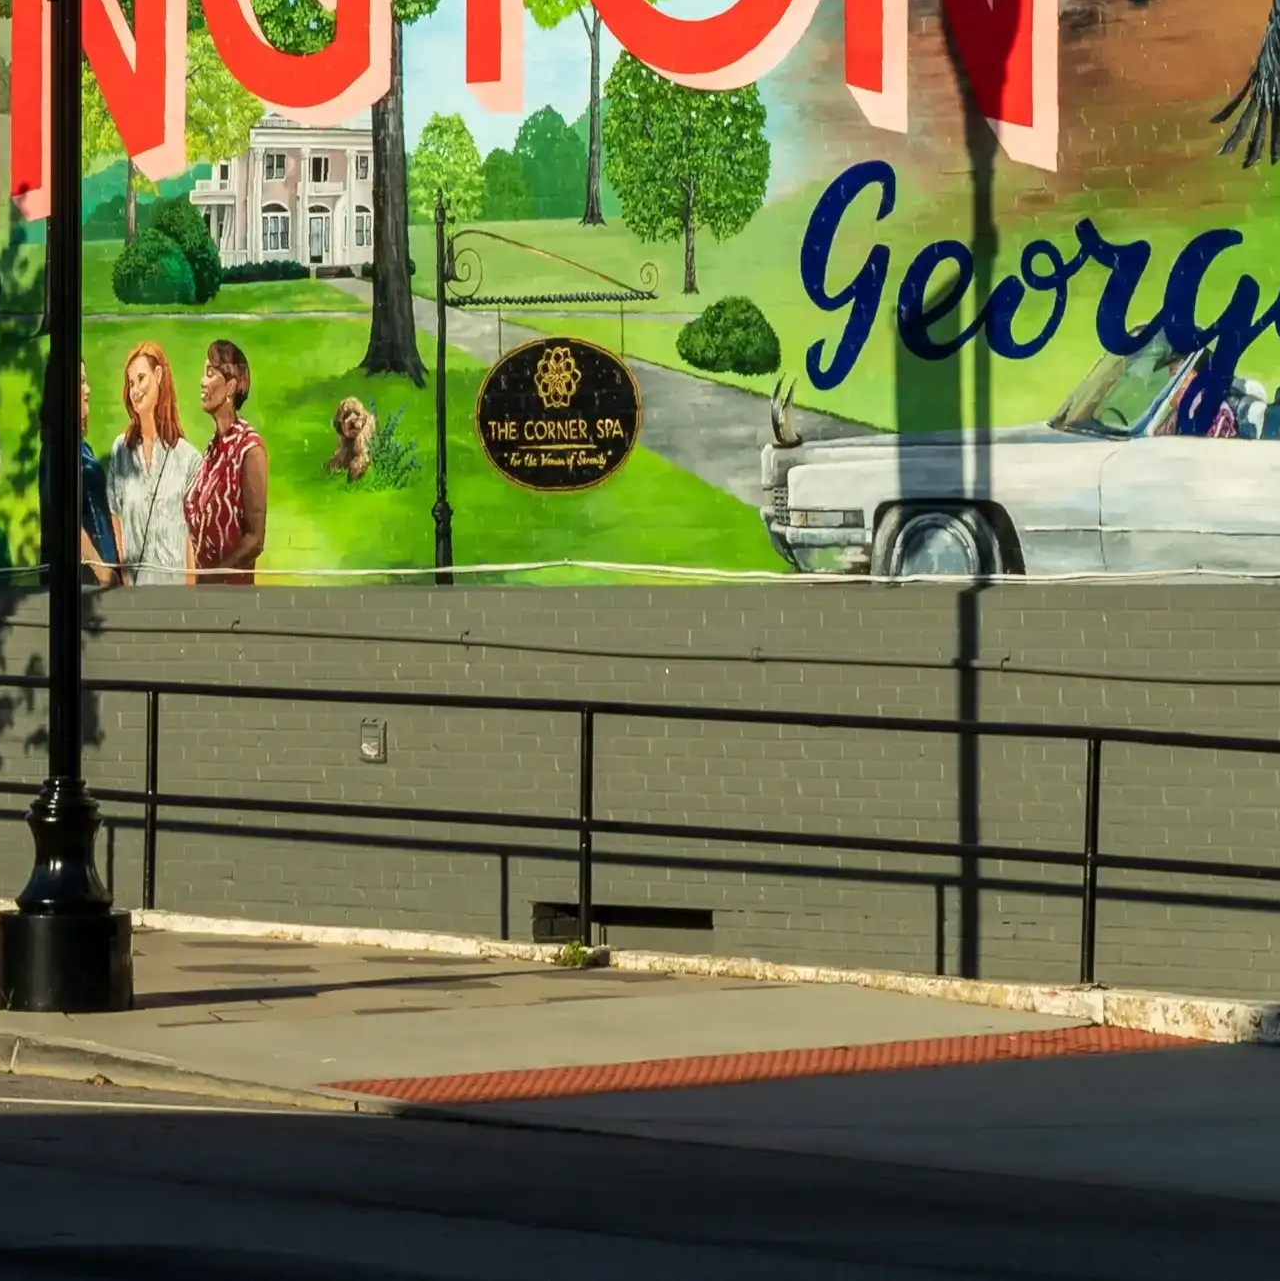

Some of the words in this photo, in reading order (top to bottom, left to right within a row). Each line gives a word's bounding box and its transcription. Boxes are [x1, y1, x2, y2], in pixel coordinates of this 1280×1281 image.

[488, 421, 517, 441] THE
[524, 419, 588, 441] CORNER
[596, 418, 625, 439] SPA
